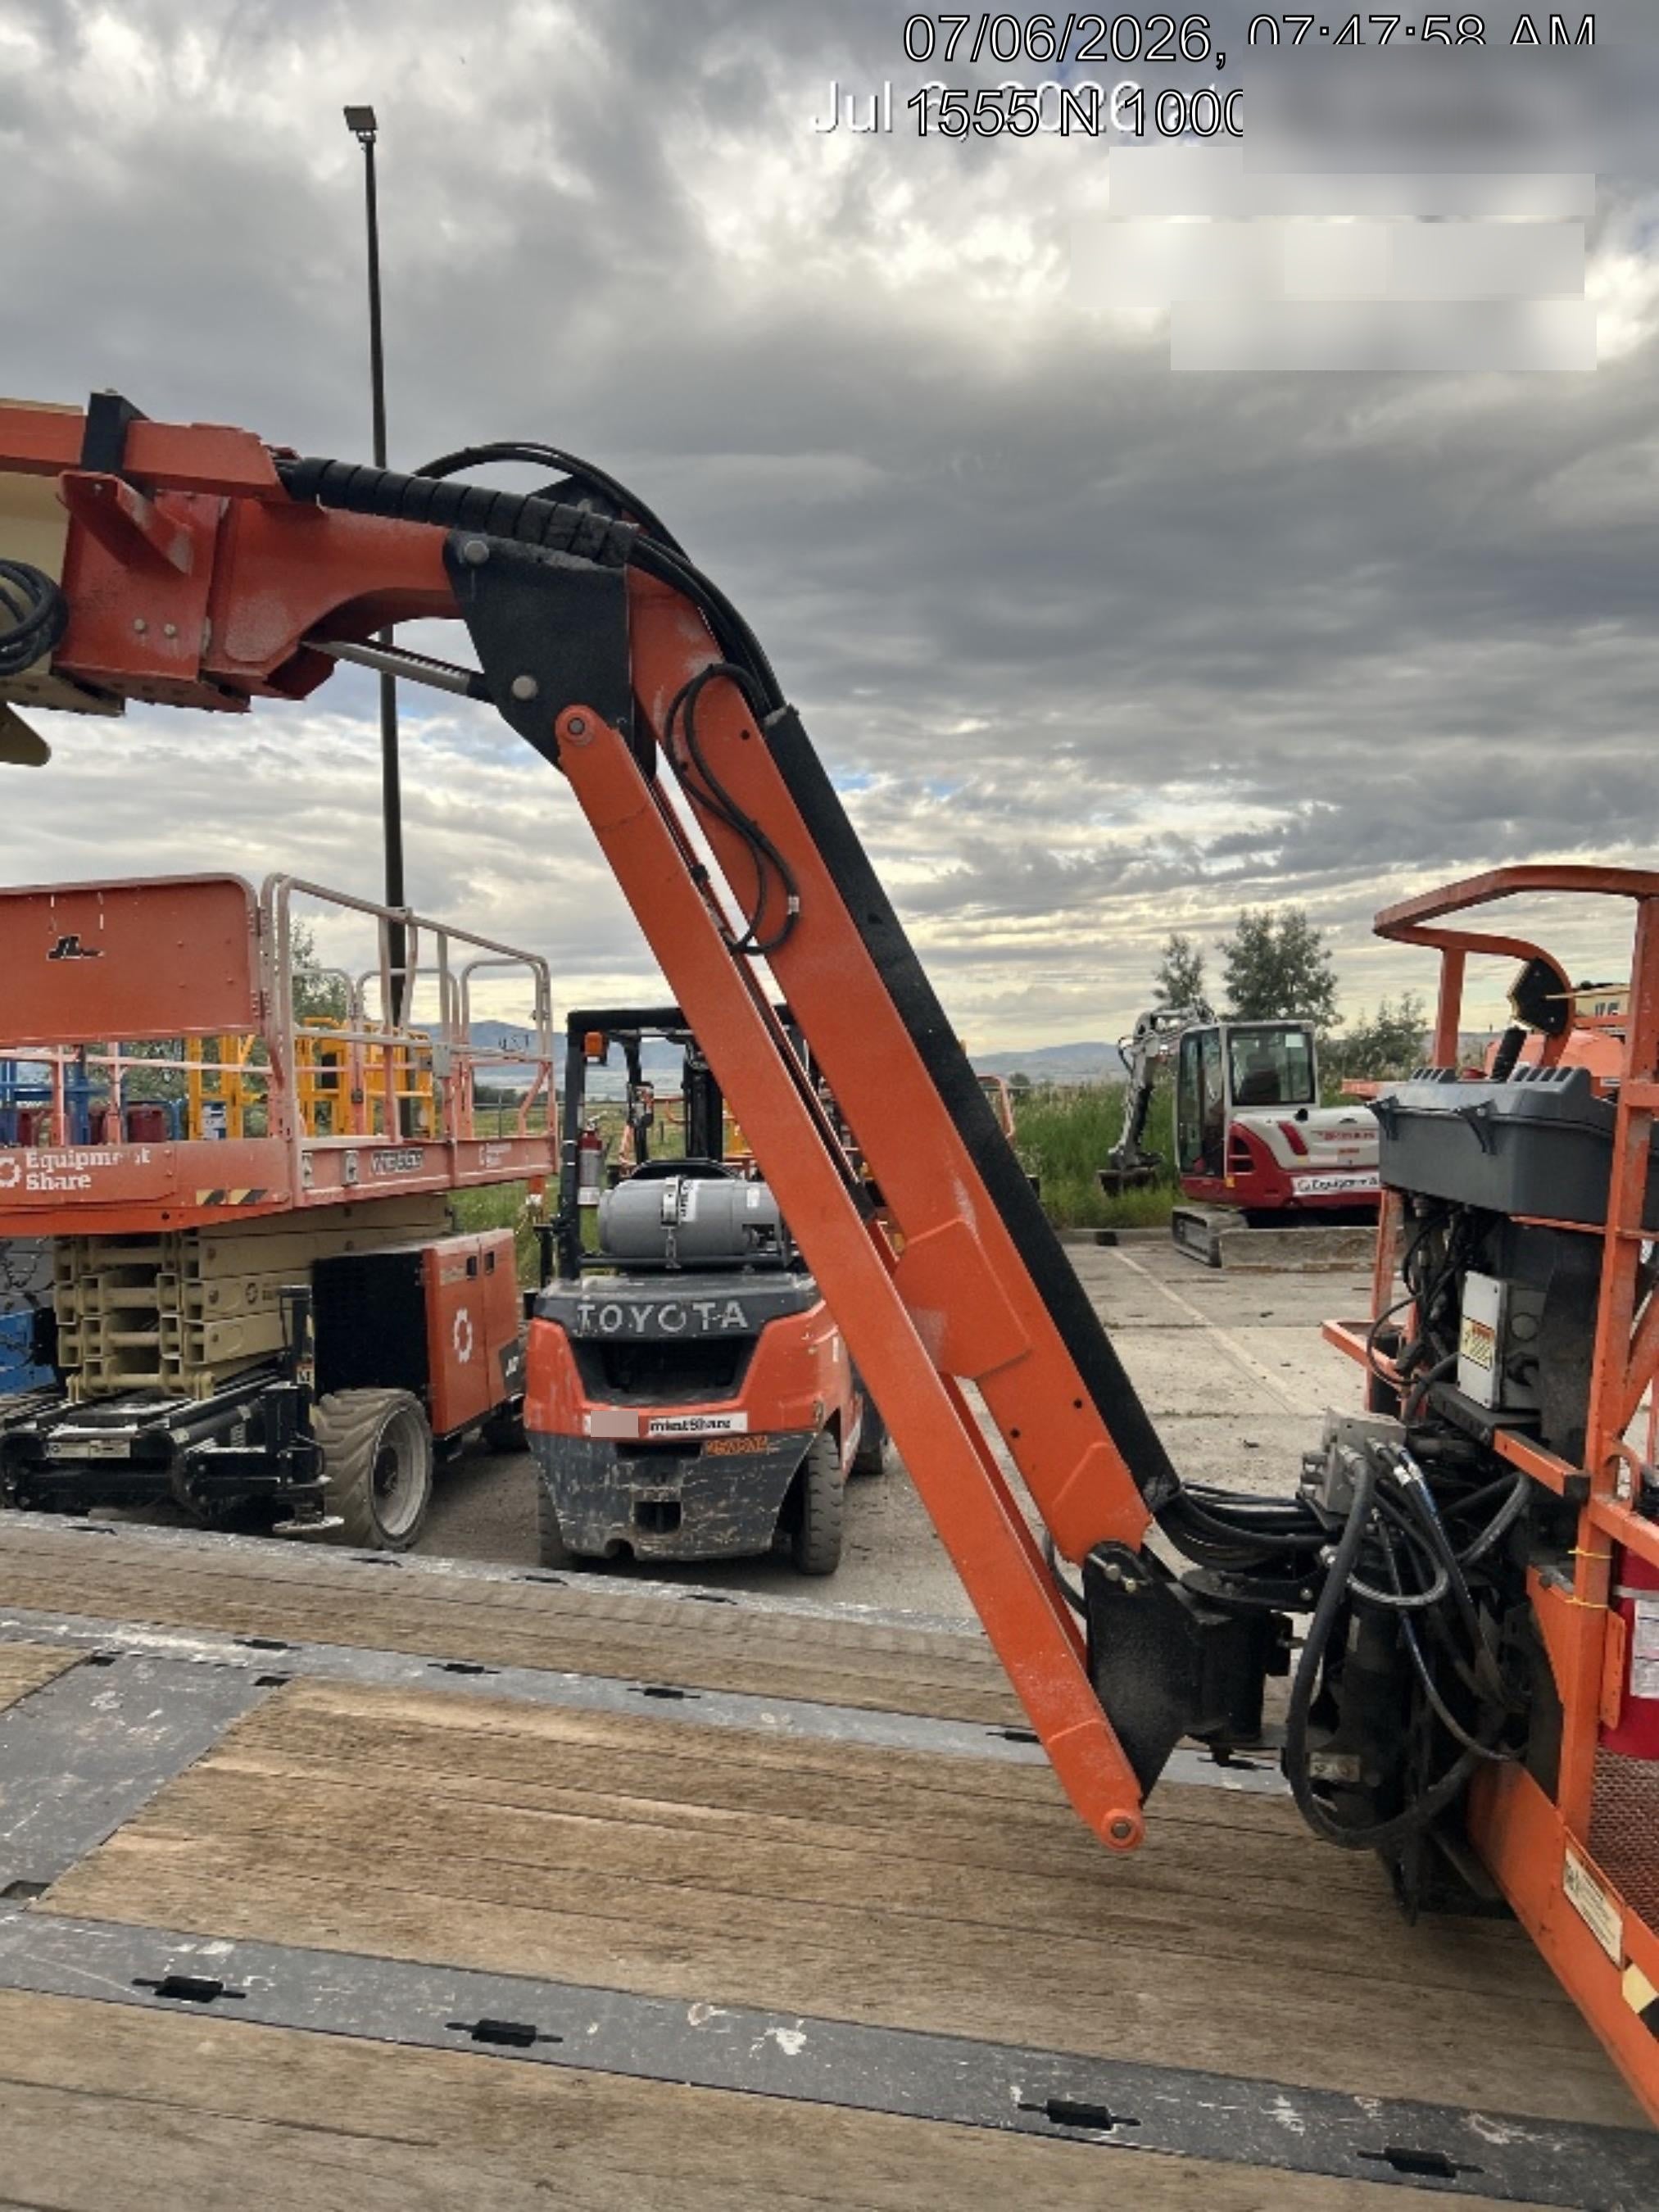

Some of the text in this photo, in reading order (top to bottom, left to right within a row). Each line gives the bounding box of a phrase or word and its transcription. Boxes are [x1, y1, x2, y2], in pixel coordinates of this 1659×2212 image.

[25, 1148, 152, 1172] Equipmt
[25, 1172, 93, 1190] Share
[577, 1300, 749, 1334] TOYOTA
